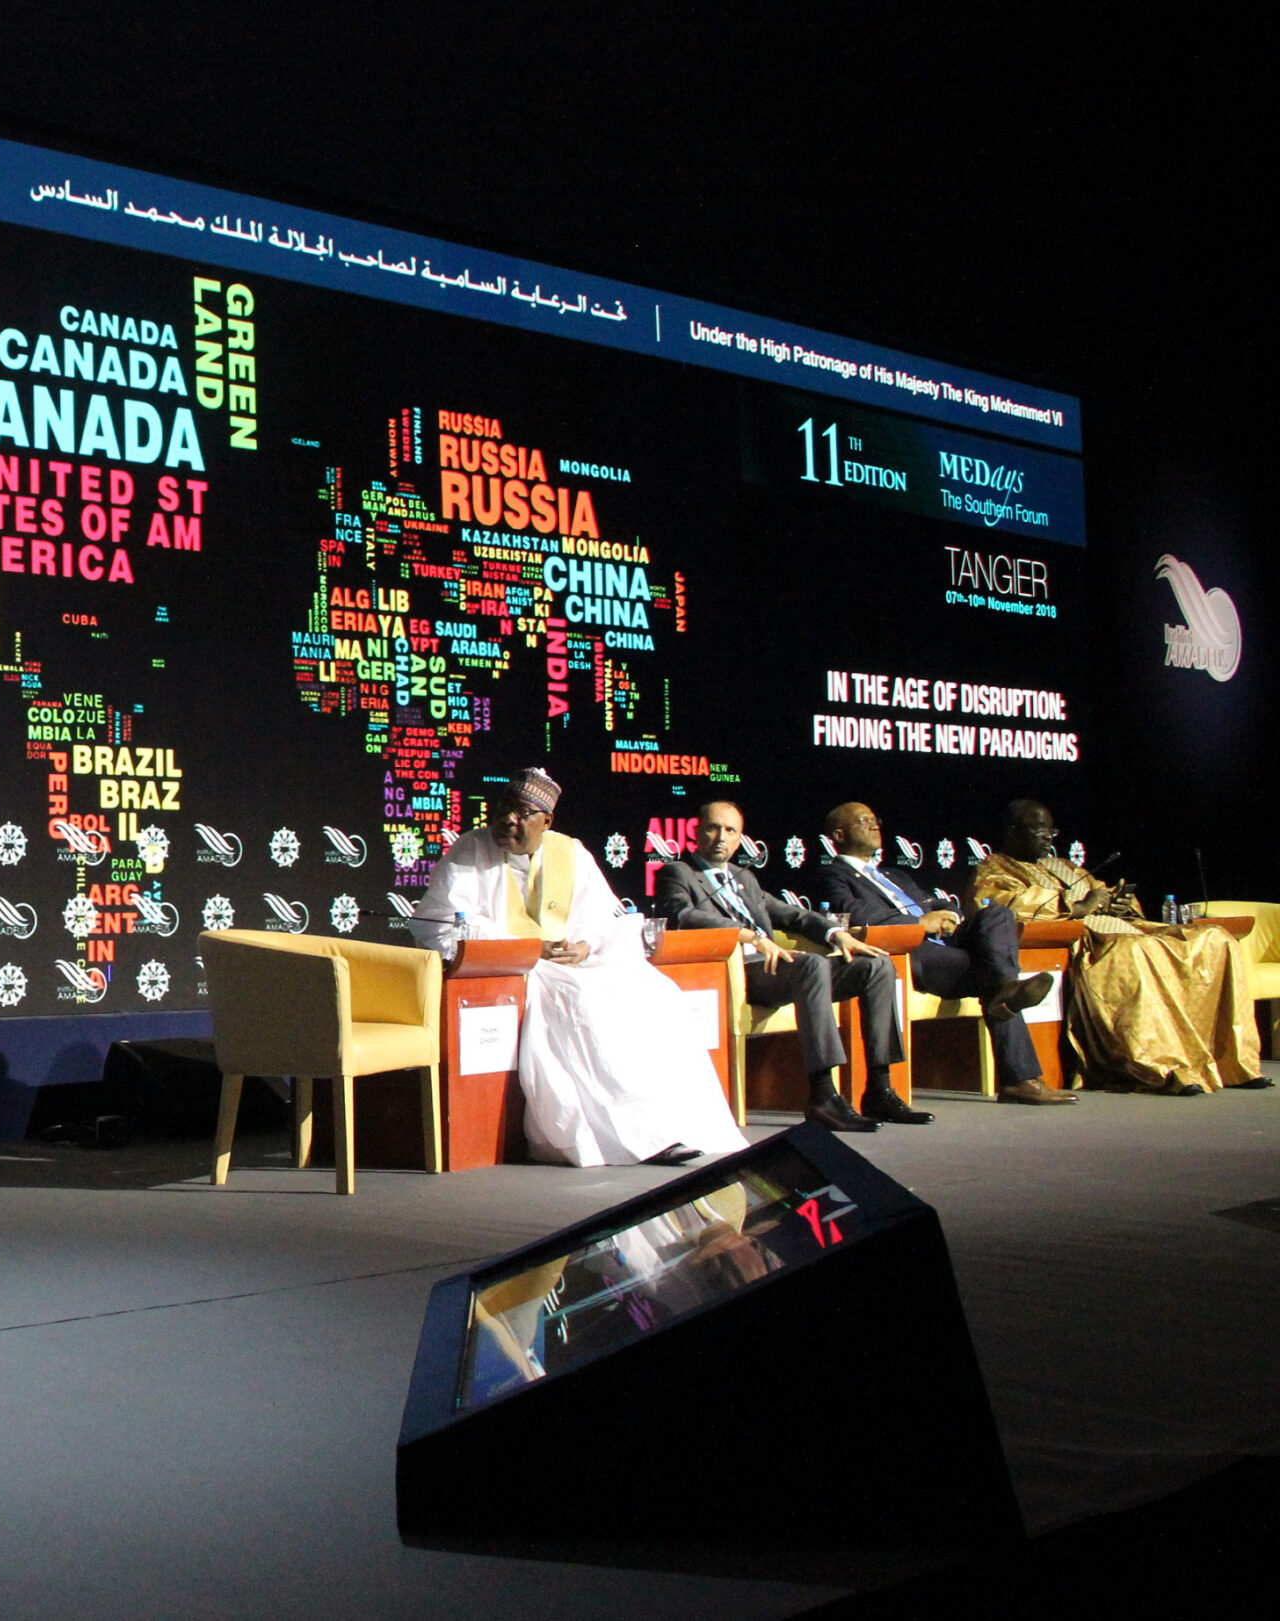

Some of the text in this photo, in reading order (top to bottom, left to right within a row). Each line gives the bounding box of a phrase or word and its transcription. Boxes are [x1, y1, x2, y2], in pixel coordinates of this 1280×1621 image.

[30, 179, 118, 212] السادس
[123, 201, 205, 232] محمد
[209, 215, 263, 243] الملك
[268, 226, 333, 262] الجلالة
[338, 249, 417, 276] لصاحب
[420, 260, 507, 296] السامية
[510, 280, 587, 315] الرعاية
[59, 305, 179, 350] CANADA
[193, 276, 224, 410] LAND
[226, 283, 258, 451] GREEN
[689, 320, 1063, 427] Under the High Patronage of His Majesty The King Mohammed VI
[401, 408, 411, 462] SWEDEN
[413, 407, 423, 465] FINLAND
[438, 409, 503, 440] RUSSIA
[388, 418, 398, 478] NORWAY
[439, 433, 549, 483] RUSSIA
[797, 417, 844, 487] 11
[848, 436, 862, 452] TH
[559, 458, 631, 483] MONGOLIA
[843, 460, 907, 492] EDITION
[938, 450, 1025, 503] MEDays
[157, 475, 209, 515] ST
[440, 470, 600, 538] RUSSIA
[940, 488, 1049, 526] The Southern Forum
[80, 503, 132, 543] OF
[146, 512, 202, 552] AM
[335, 512, 362, 528] FRA
[335, 528, 363, 544] NCE
[403, 519, 450, 534] UKRAINE
[365, 527, 376, 571] ITALY
[461, 527, 559, 554] KAZAKHSTAN
[473, 545, 543, 565] UZBEKISTAN
[561, 535, 651, 565] MONGOLIA
[0, 535, 135, 584] ERICA
[412, 563, 461, 580] TURKEY
[944, 546, 1048, 599] TANGIER
[466, 580, 506, 599] IRAN
[543, 556, 651, 601] CHINA
[330, 586, 371, 610] ALG
[377, 587, 411, 613] LIB
[564, 594, 650, 630] CHINA
[674, 571, 687, 633] JAPAN
[987, 596, 1034, 616] November
[1035, 603, 1057, 619] 2018
[62, 612, 98, 626] CUBA
[330, 609, 379, 634] ERIA
[435, 620, 477, 639] SAUDI
[450, 637, 503, 658] ARABIA
[604, 630, 655, 651] CHINA
[395, 638, 410, 706] CHAD
[458, 657, 492, 668] YEMEN
[546, 617, 569, 718] INDIA
[594, 641, 605, 703] BURMA
[63, 692, 103, 709] VENE
[604, 659, 615, 731] THAILAND
[827, 670, 1068, 721] IN THE AGE OF DISRUPTION:
[27, 706, 75, 725] COLO
[28, 724, 72, 742] MBIA
[615, 739, 659, 751] MALAYSIA
[813, 714, 1080, 762] FINDING THE NEW PARADIGMS
[72, 744, 183, 778] BRAZIL
[610, 751, 711, 776] INDONESIA
[709, 773, 741, 783] GUINEA
[48, 751, 69, 839] PERU
[100, 779, 181, 811] BRAZ
[111, 858, 143, 869] PARA
[111, 870, 143, 882] GUAY
